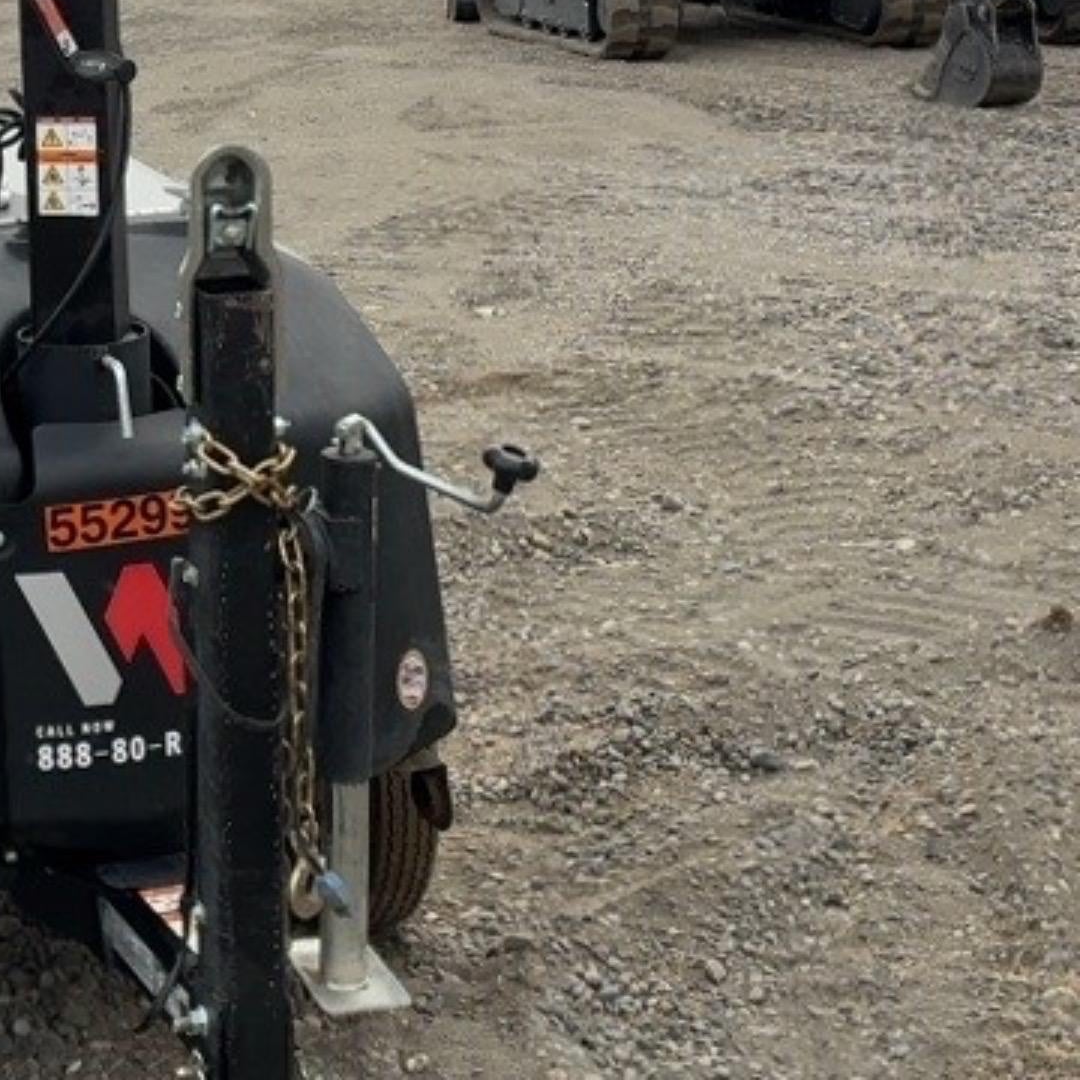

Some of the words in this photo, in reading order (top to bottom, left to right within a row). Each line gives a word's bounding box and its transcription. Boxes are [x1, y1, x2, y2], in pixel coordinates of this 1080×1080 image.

[35, 723, 75, 739] CALL
[81, 719, 116, 735] NOW
[37, 730, 183, 772] 888-80-R
